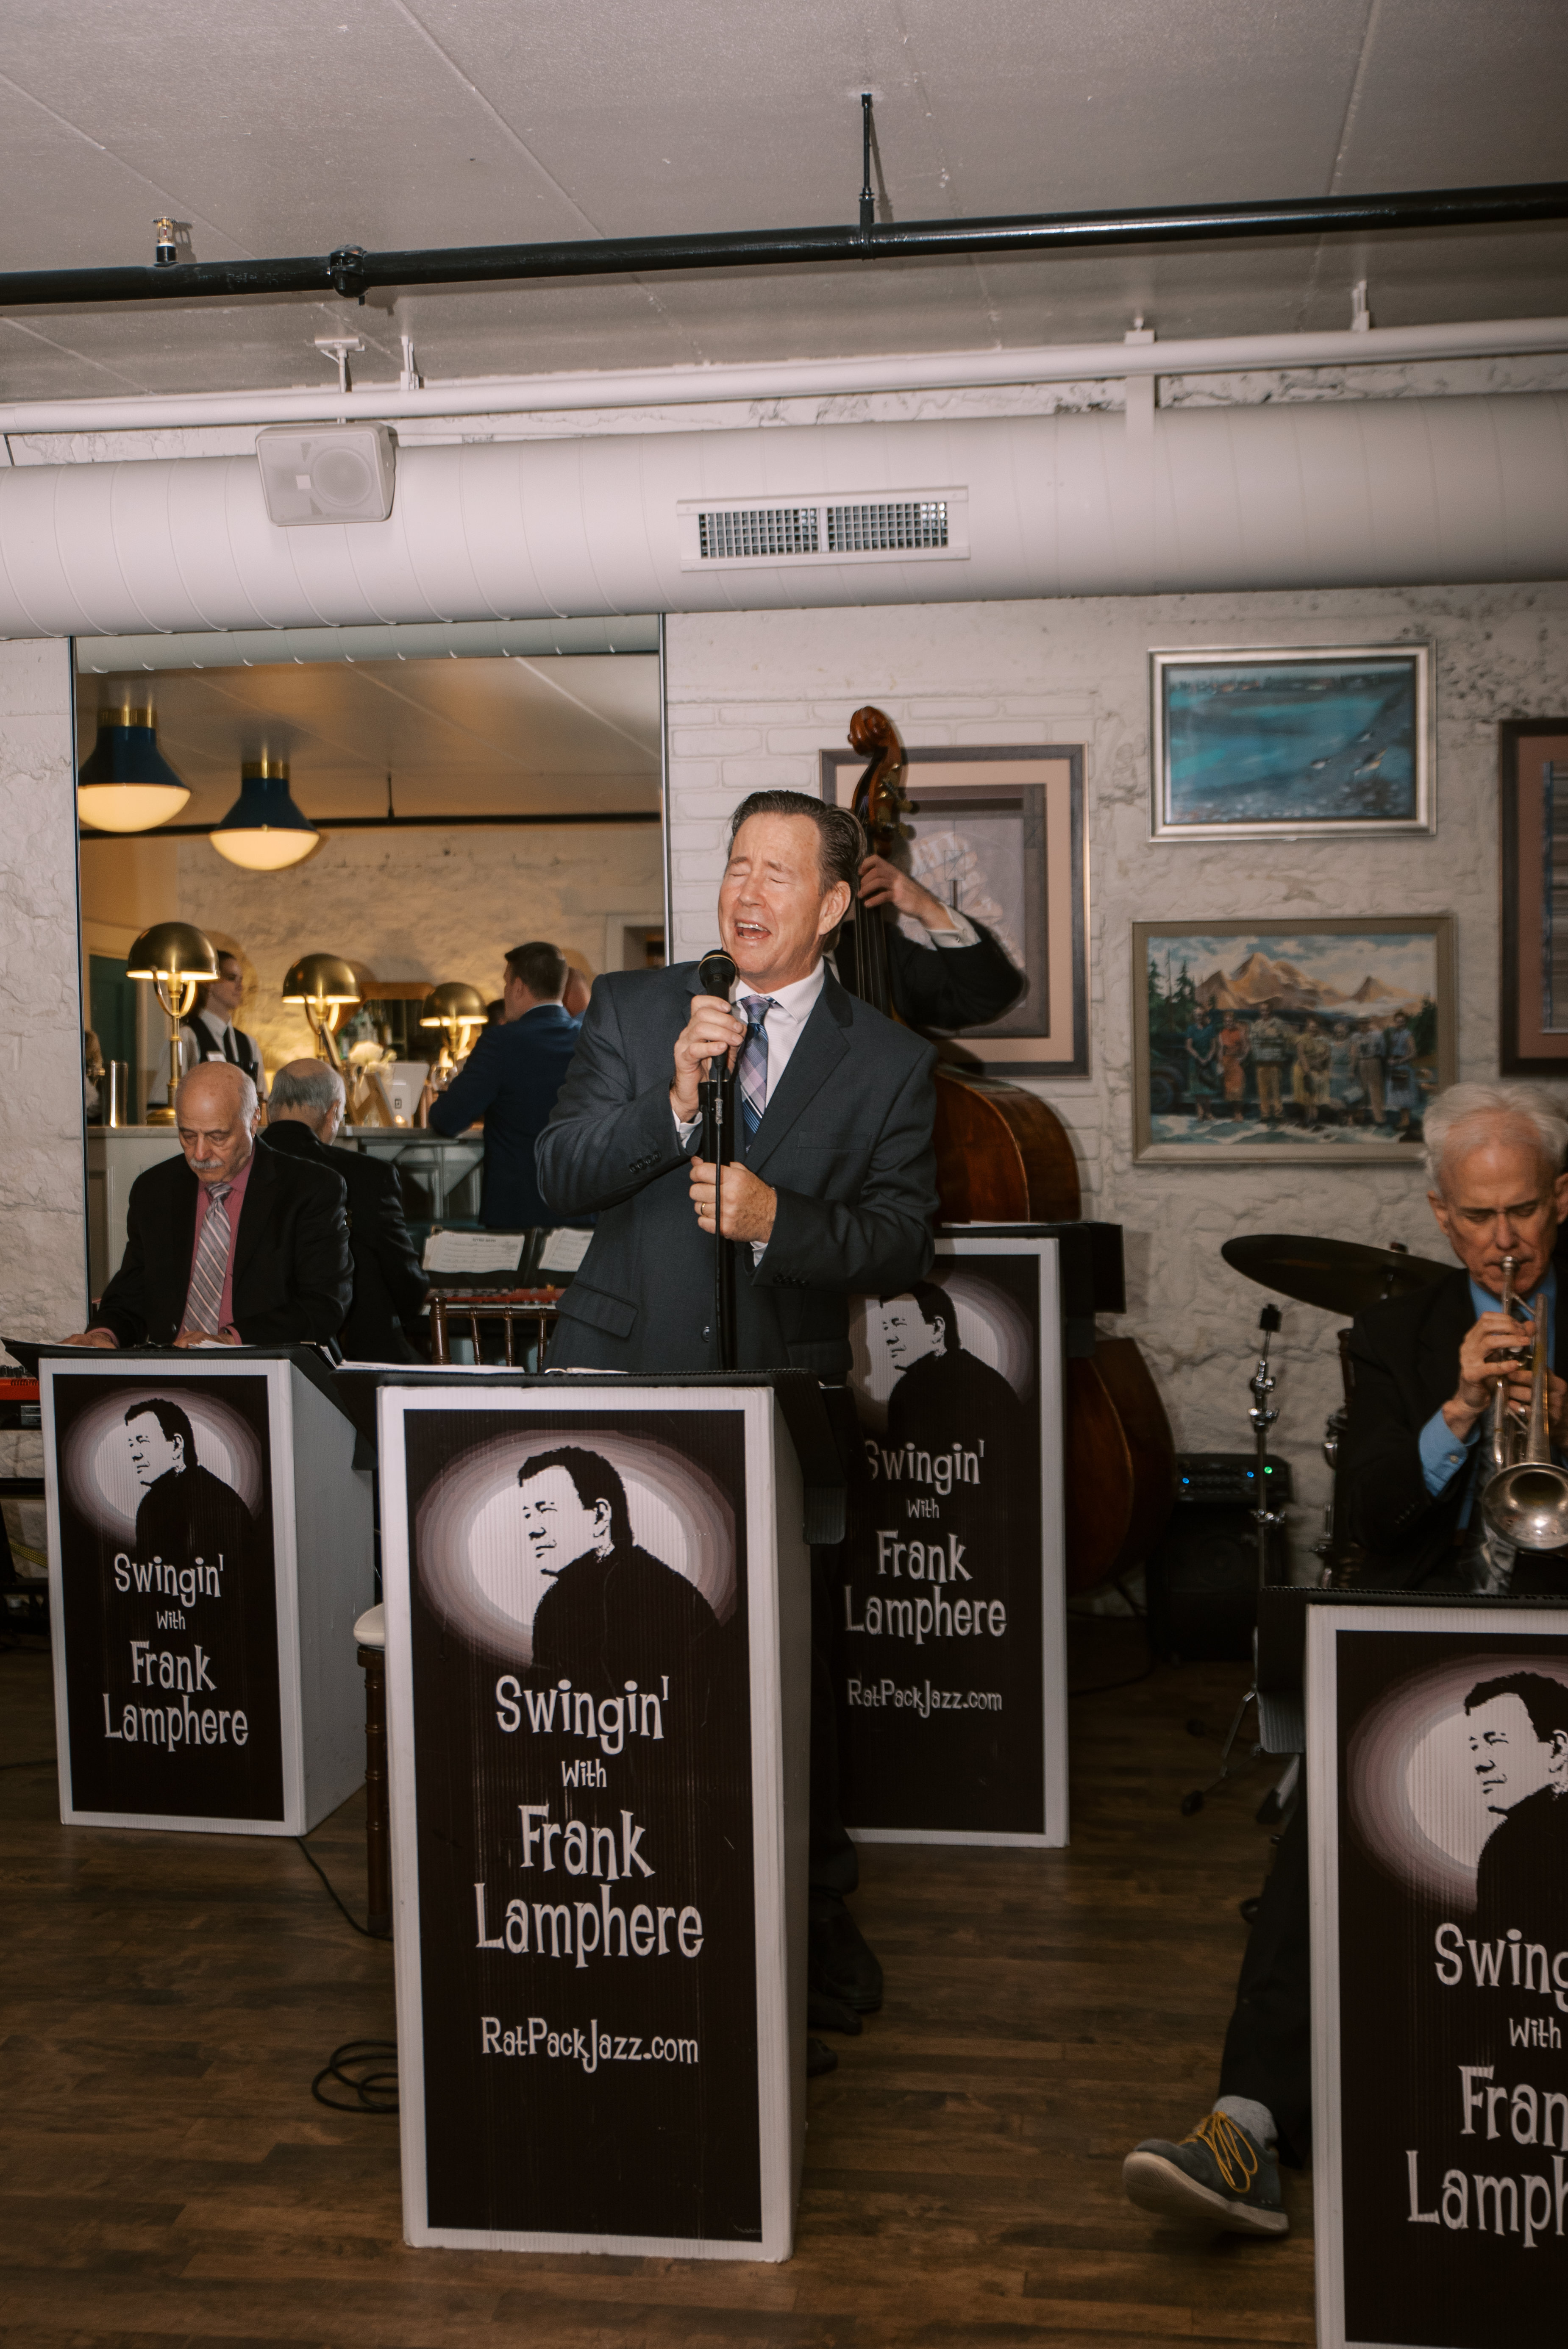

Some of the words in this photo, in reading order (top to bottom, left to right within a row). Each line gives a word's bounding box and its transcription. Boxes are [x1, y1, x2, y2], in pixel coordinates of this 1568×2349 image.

[907, 1498, 940, 1518] With
[114, 1553, 224, 1607] Swingin'
[876, 1530, 973, 1583] Frank
[156, 1610, 186, 1630] With
[845, 1584, 1007, 1645] Lamphere
[130, 1640, 217, 1693] Frank
[102, 1693, 249, 1752] Lamphere
[495, 1675, 669, 1755] Swingin'
[848, 1678, 1003, 1718] RatPackJazz.com
[561, 1758, 607, 1787] With
[518, 1803, 656, 1881] Frank
[474, 1882, 704, 1968] Lamphere
[481, 2016, 699, 2074] RatPackJazz.com
[1509, 2016, 1562, 2049] With
